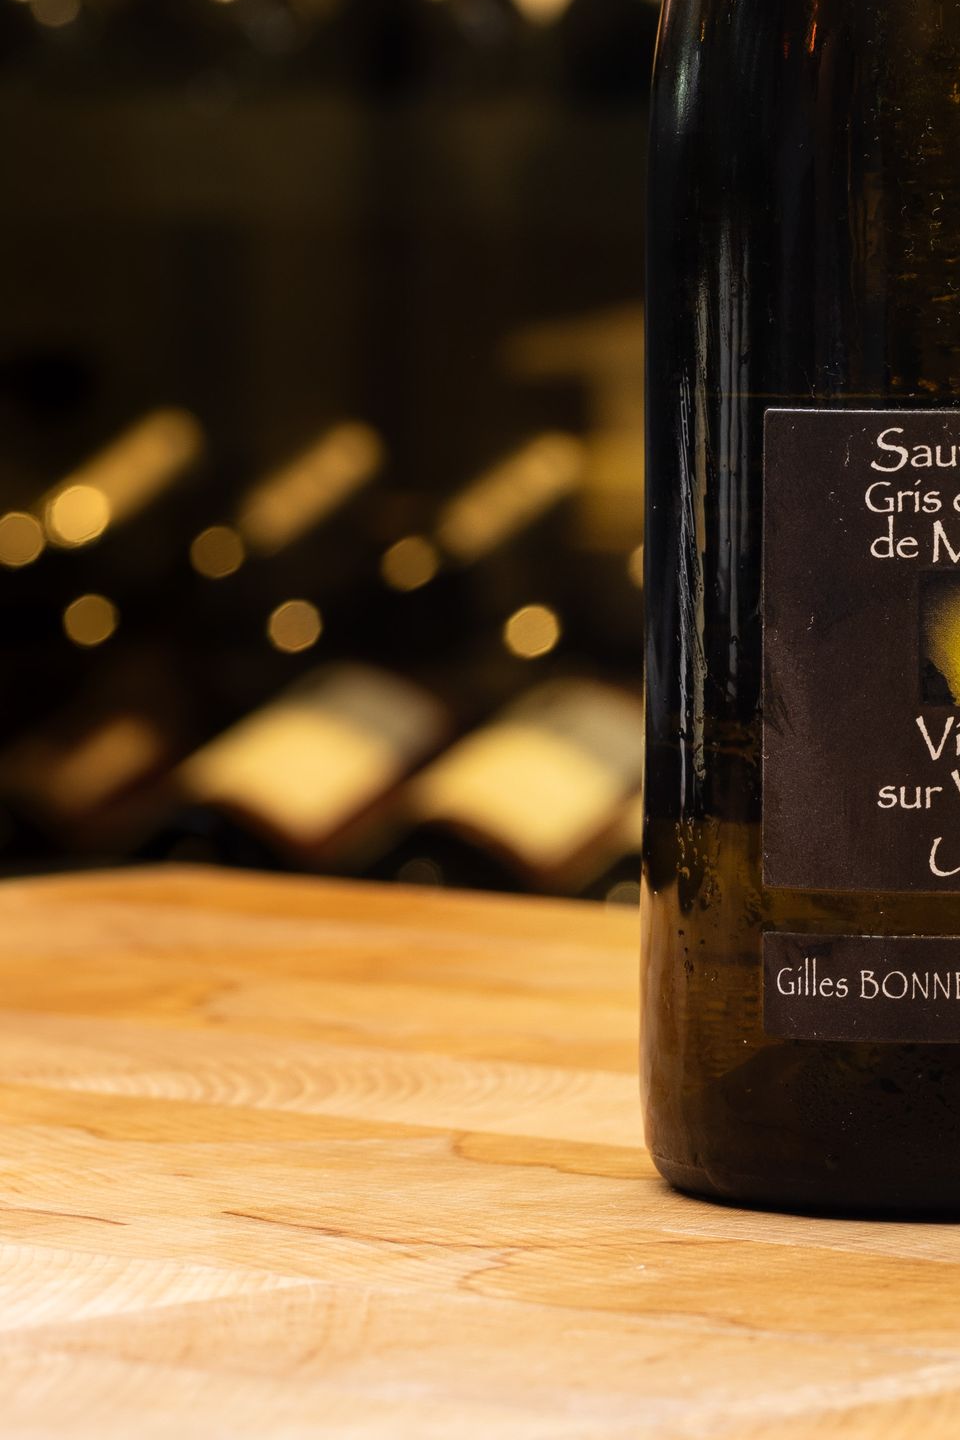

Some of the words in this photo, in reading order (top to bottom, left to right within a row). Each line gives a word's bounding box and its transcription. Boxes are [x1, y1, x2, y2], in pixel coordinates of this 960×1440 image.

[864, 481, 943, 514] Gris
[870, 514, 919, 559] de
[877, 785, 943, 809] sur
[776, 957, 849, 998] Gilles
